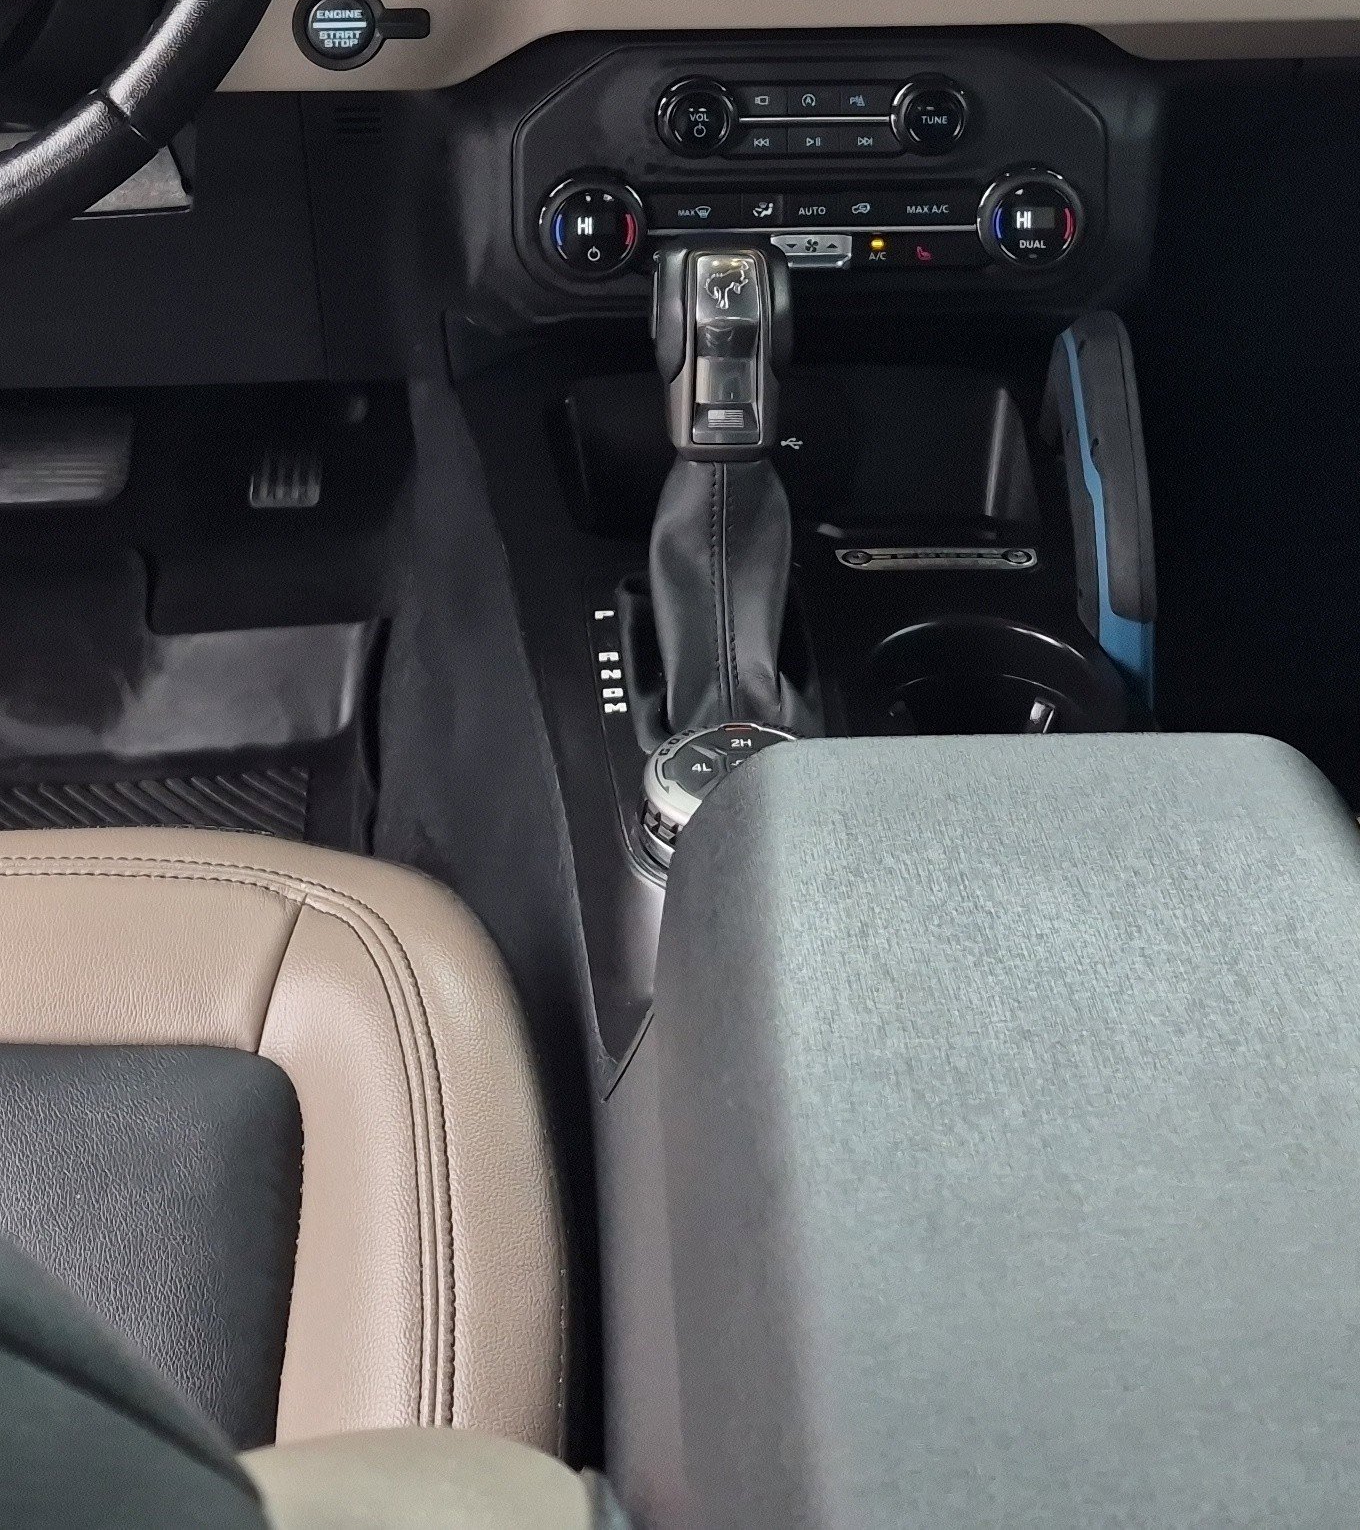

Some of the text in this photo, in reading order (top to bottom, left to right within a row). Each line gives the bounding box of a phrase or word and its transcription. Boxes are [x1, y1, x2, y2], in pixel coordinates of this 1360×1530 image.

[316, 9, 363, 19] ENGINE
[319, 30, 362, 39] START
[324, 39, 358, 48] STOP
[690, 113, 709, 122] VOL
[921, 115, 948, 125] TUNE
[677, 209, 695, 217] MAX
[798, 206, 826, 216] AUTO
[906, 204, 949, 215] MAX A/C
[1016, 211, 1031, 229] HI
[577, 216, 593, 235] HI
[1019, 240, 1046, 249] DUAL
[869, 251, 886, 261] A/C
[595, 610, 615, 620] P
[601, 669, 621, 680] N
[604, 702, 627, 713] M
[730, 739, 752, 748] 2H
[691, 763, 713, 772] 4L
